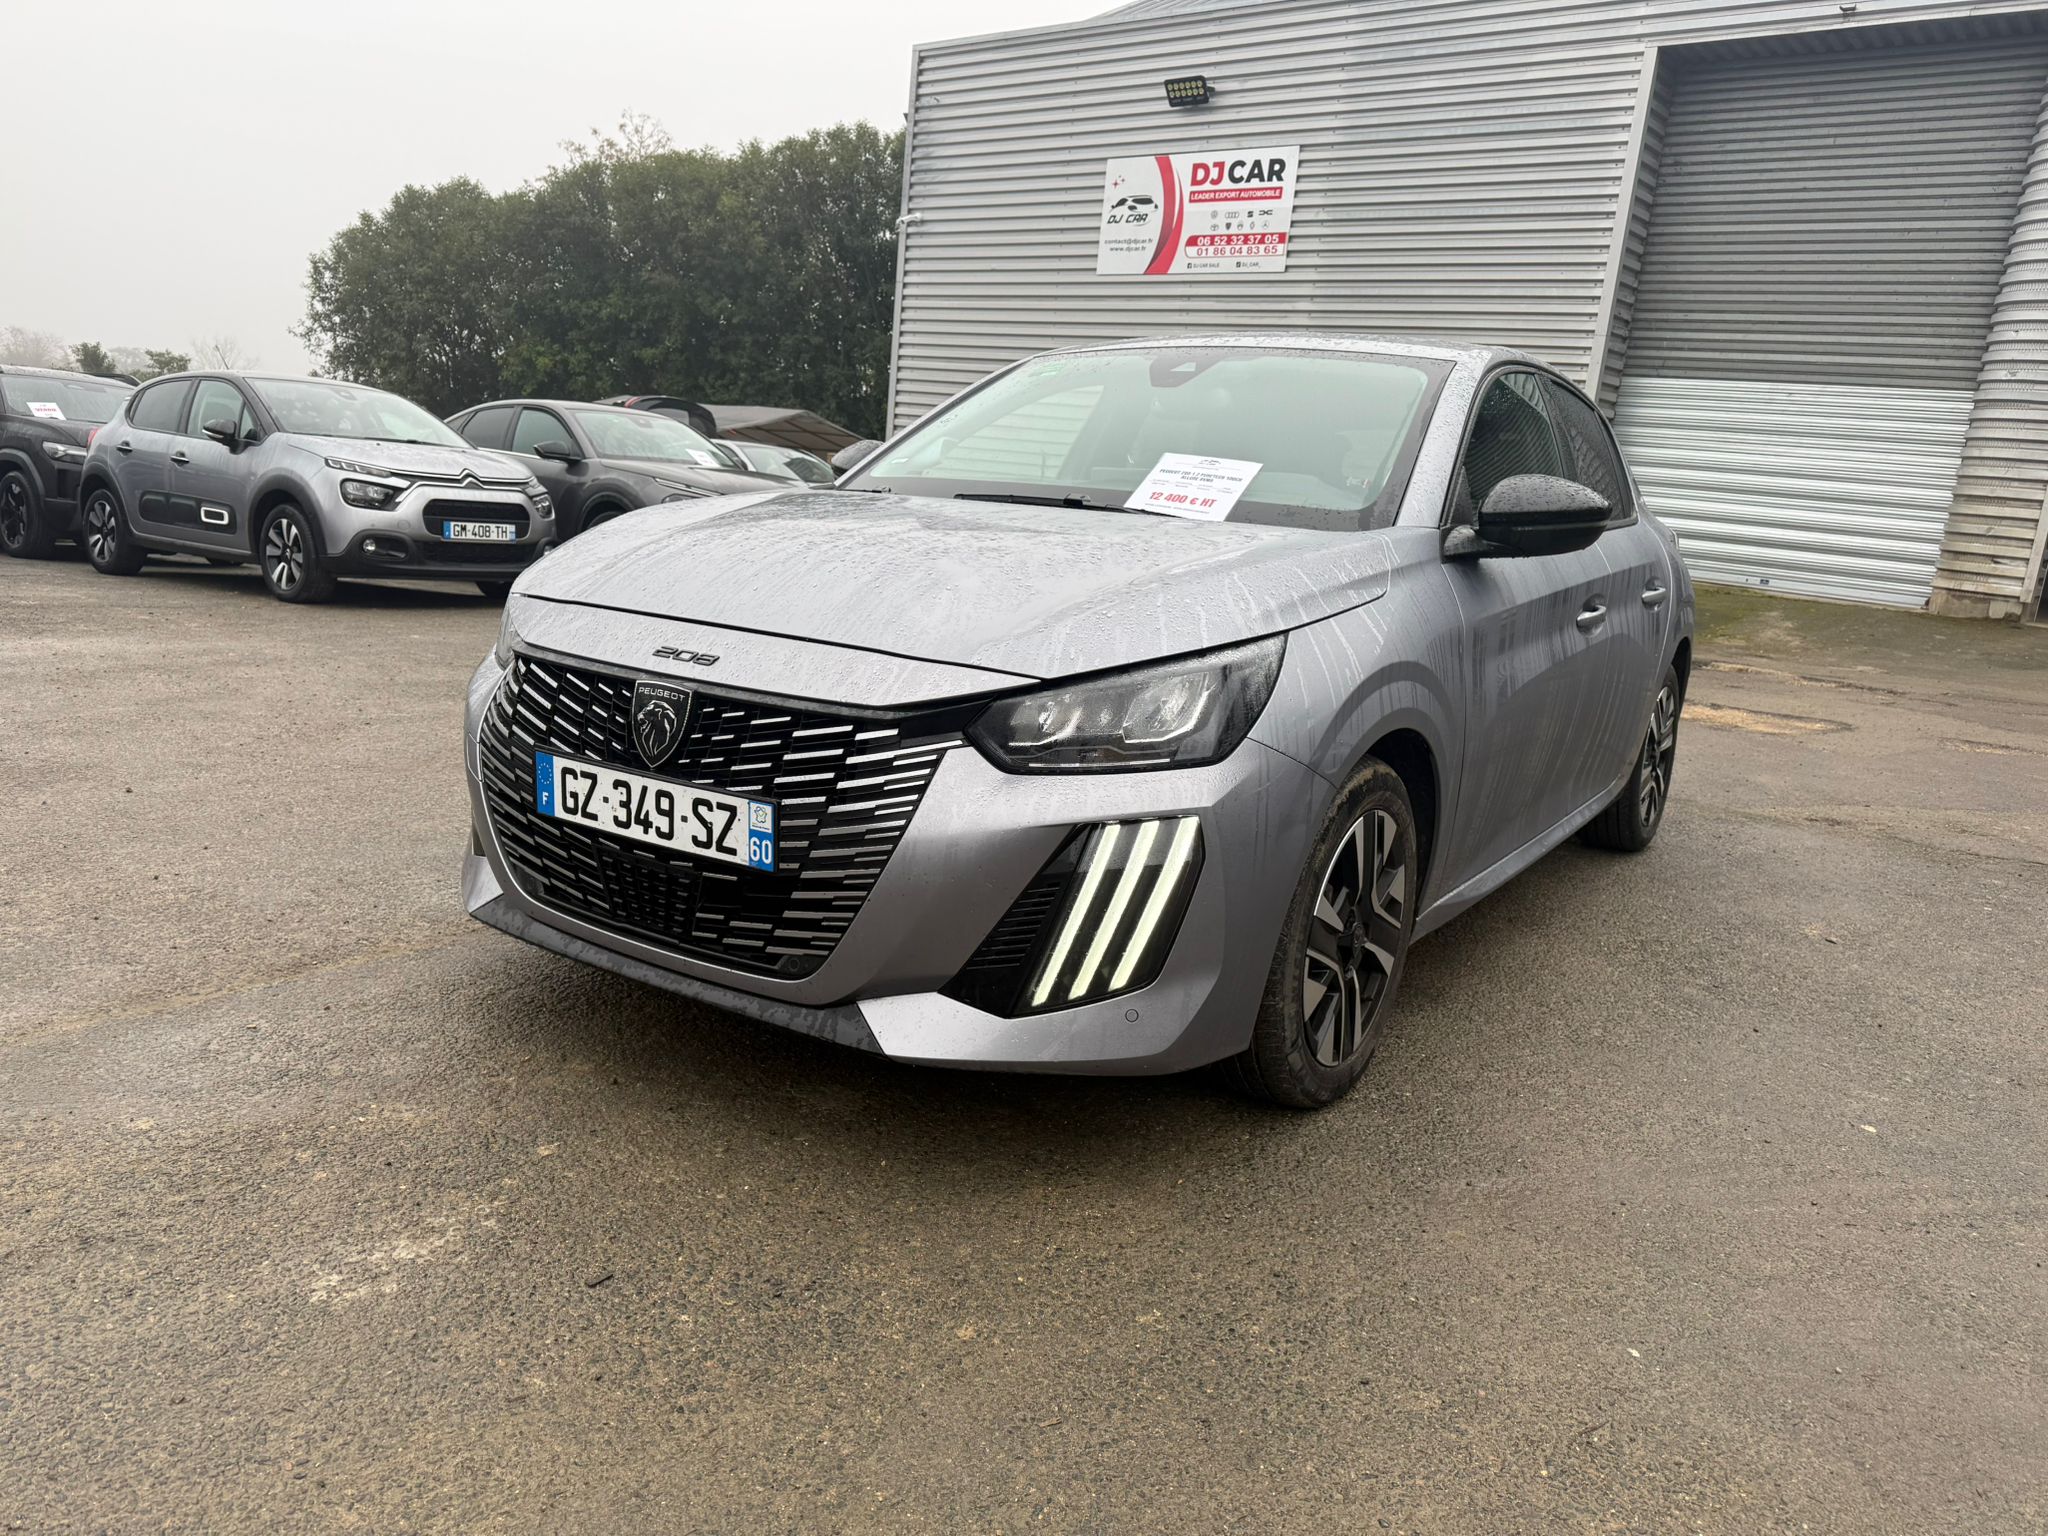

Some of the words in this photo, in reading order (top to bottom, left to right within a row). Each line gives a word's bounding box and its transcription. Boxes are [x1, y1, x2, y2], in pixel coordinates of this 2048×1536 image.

[1190, 192, 1215, 200] LEADER
[1215, 190, 1239, 199] EXPORT
[1240, 188, 1281, 198] AUTOMOBILE
[1107, 214, 1124, 224] DJ
[1125, 213, 1149, 224] CAR
[1197, 236, 1211, 246] 06
[1213, 236, 1228, 246] 52
[1230, 235, 1245, 245] 32
[1247, 234, 1262, 244] 37
[1264, 234, 1279, 244] 05
[1109, 245, 1147, 253] www.djcar.fr
[1197, 247, 1209, 256] 01
[1213, 246, 1226, 256] 86
[1229, 246, 1243, 255] 04
[1246, 245, 1260, 255] 83
[1263, 245, 1278, 254] 65
[1149, 491, 1164, 501] 12
[1164, 493, 1188, 504] 400
[1190, 497, 1199, 505] €
[1200, 498, 1217, 508] HT
[453, 524, 508, 539] GM-408-TH
[652, 645, 721, 667] 208
[638, 686, 686, 703] PEUGEOT
[542, 792, 549, 807] F
[560, 766, 739, 857] GZ-349-SZ
[749, 836, 773, 865] 60
